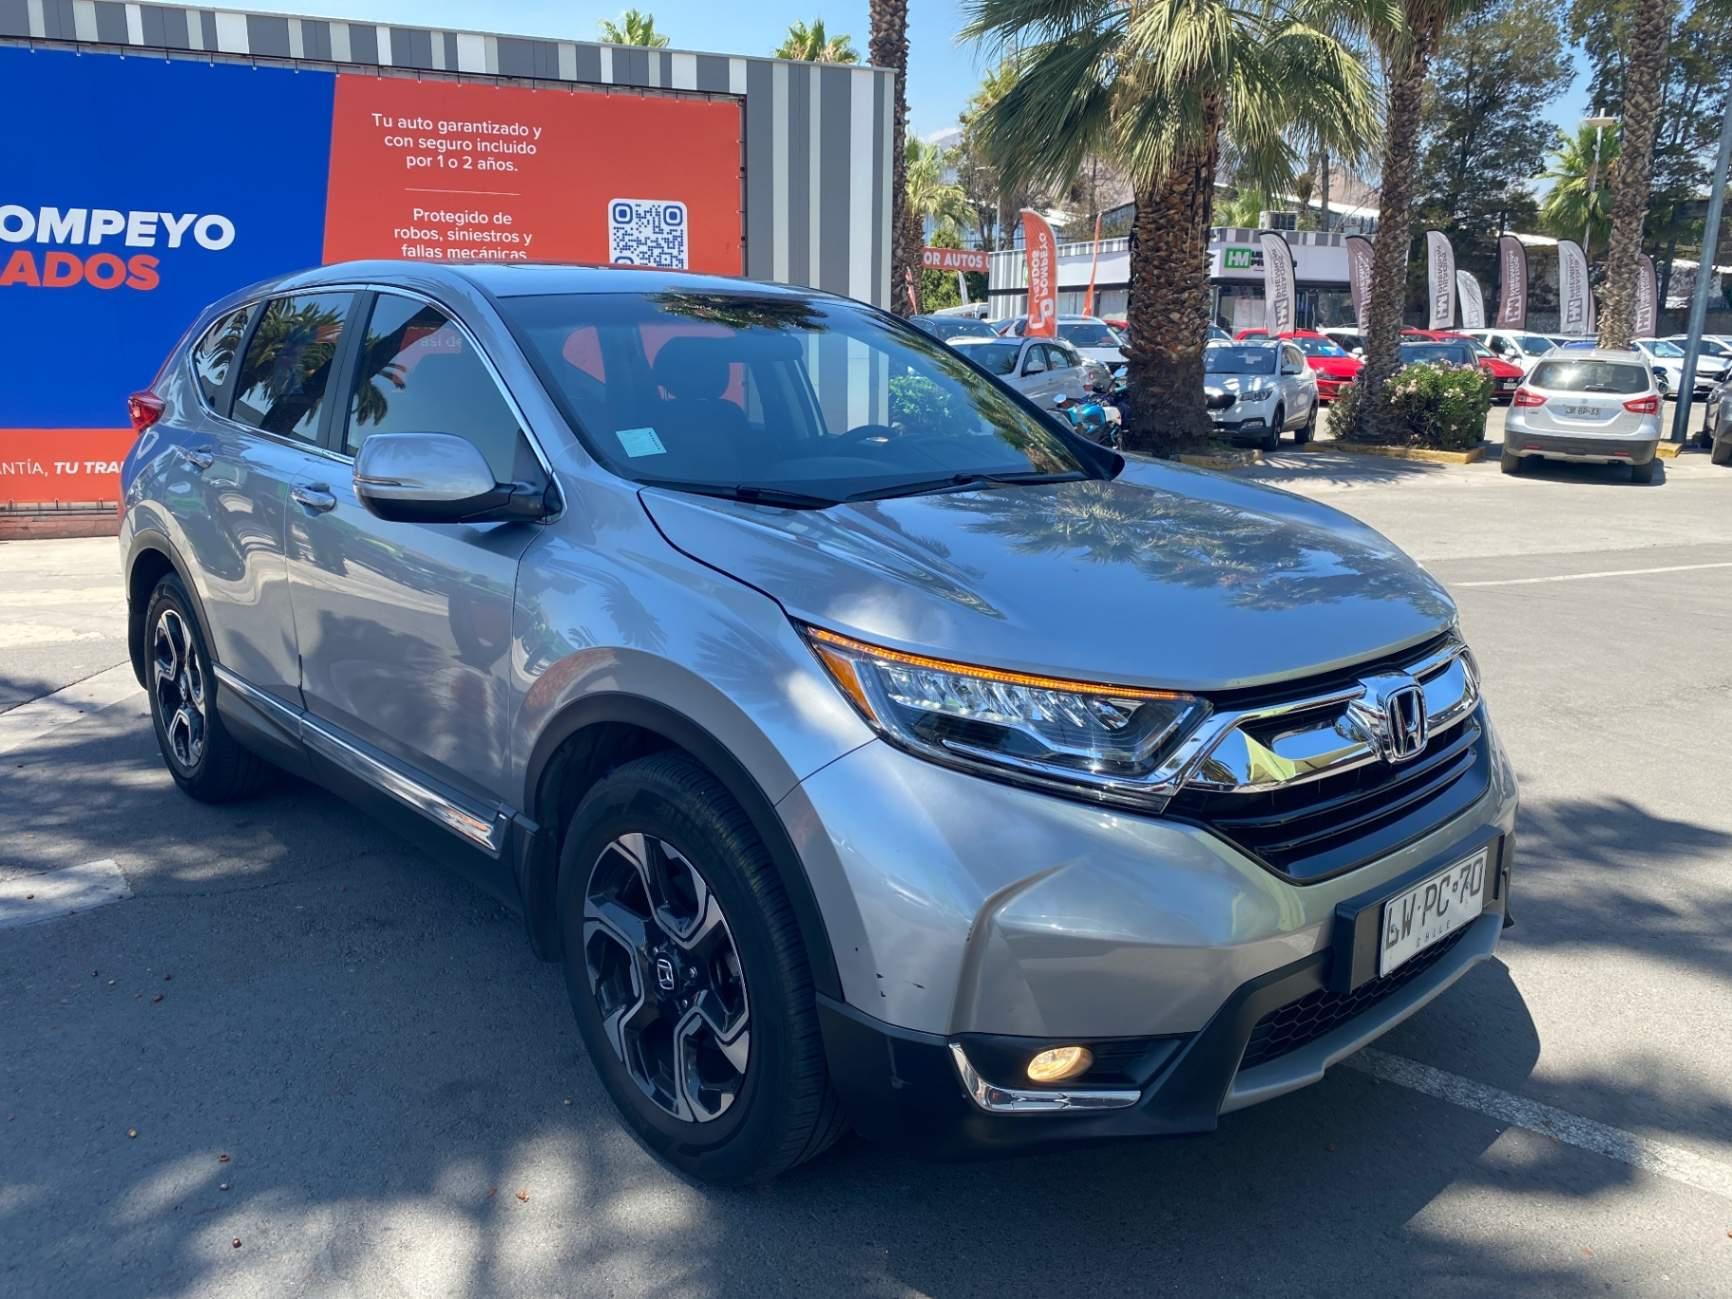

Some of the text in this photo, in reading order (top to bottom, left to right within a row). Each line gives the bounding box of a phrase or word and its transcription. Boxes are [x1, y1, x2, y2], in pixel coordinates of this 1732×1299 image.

[371, 113, 542, 139] Tu auto garantizado y
[384, 135, 537, 155] con seguro incluido
[406, 155, 519, 172] por 1 o 2 años.
[413, 208, 513, 226] Protegido de
[0, 204, 235, 251] OMPEYO
[394, 227, 533, 246] robos, siniestros y
[401, 244, 527, 259] fallas mecánicas
[944, 252, 982, 268] AUTOS
[1227, 249, 1250, 267] HM
[1, 250, 160, 290] ADOS
[0, 458, 123, 477] NTÍA, TU TRA
